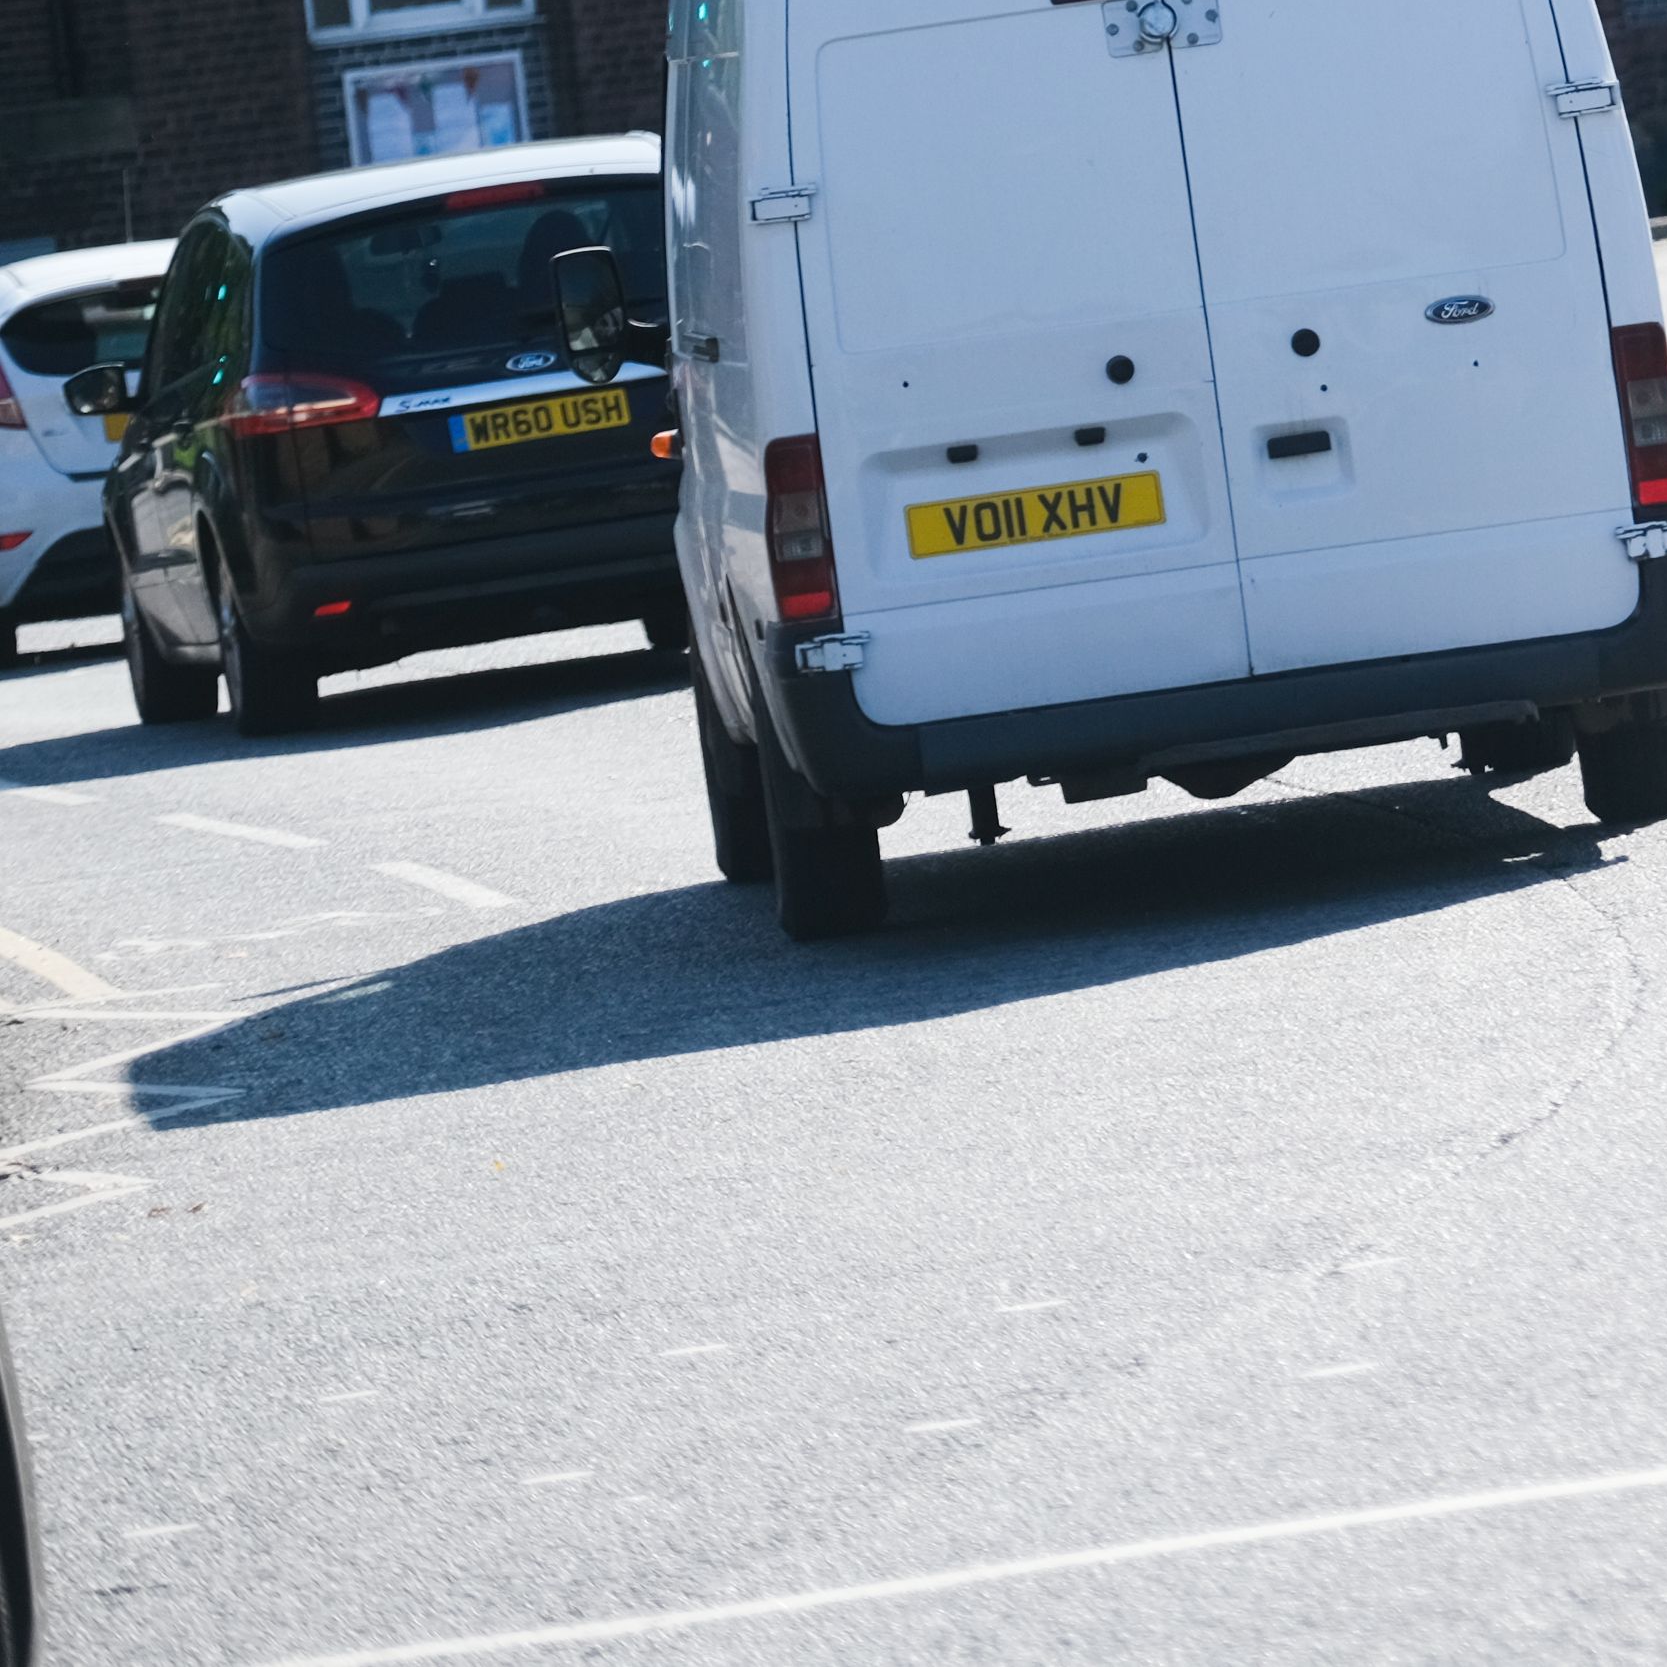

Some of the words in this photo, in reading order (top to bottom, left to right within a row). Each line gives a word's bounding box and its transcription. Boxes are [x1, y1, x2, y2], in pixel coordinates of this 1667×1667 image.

[1440, 300, 1480, 319] Ford
[468, 404, 554, 446] WR60
[559, 395, 624, 429] USH
[1036, 482, 1122, 534] XHV
